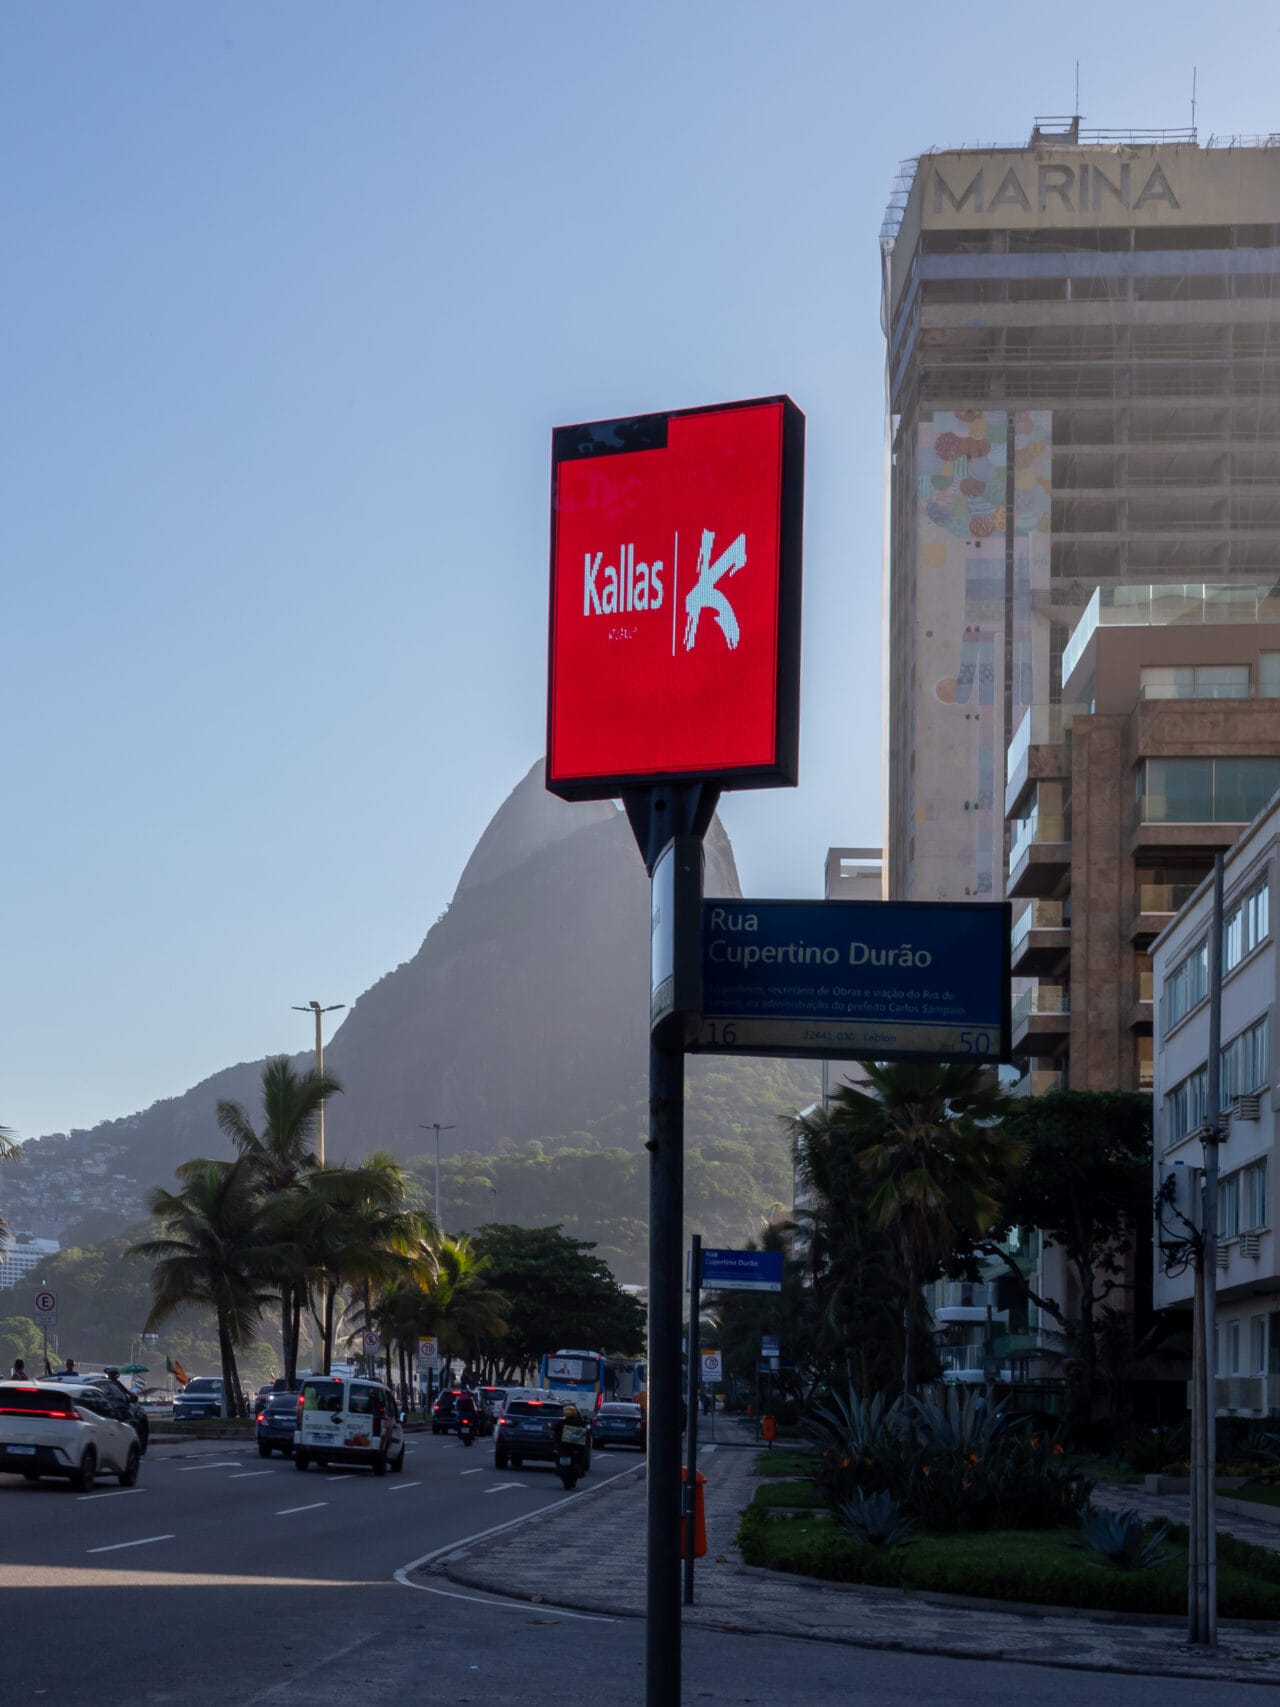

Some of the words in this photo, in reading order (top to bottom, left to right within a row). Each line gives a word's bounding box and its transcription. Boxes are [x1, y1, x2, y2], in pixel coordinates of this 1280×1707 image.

[933, 162, 1181, 215] MARINA
[583, 543, 664, 616] Kallas
[683, 528, 747, 651] K
[710, 908, 759, 931] Rua
[708, 939, 840, 968] Cupertino
[849, 942, 933, 968] Durão
[832, 986, 861, 996] Obras
[888, 1003, 918, 1013] Carlos
[707, 1023, 736, 1044] 16
[960, 1031, 990, 1055] 50
[705, 1258, 737, 1266] Cupertino
[42, 1296, 49, 1307] E
